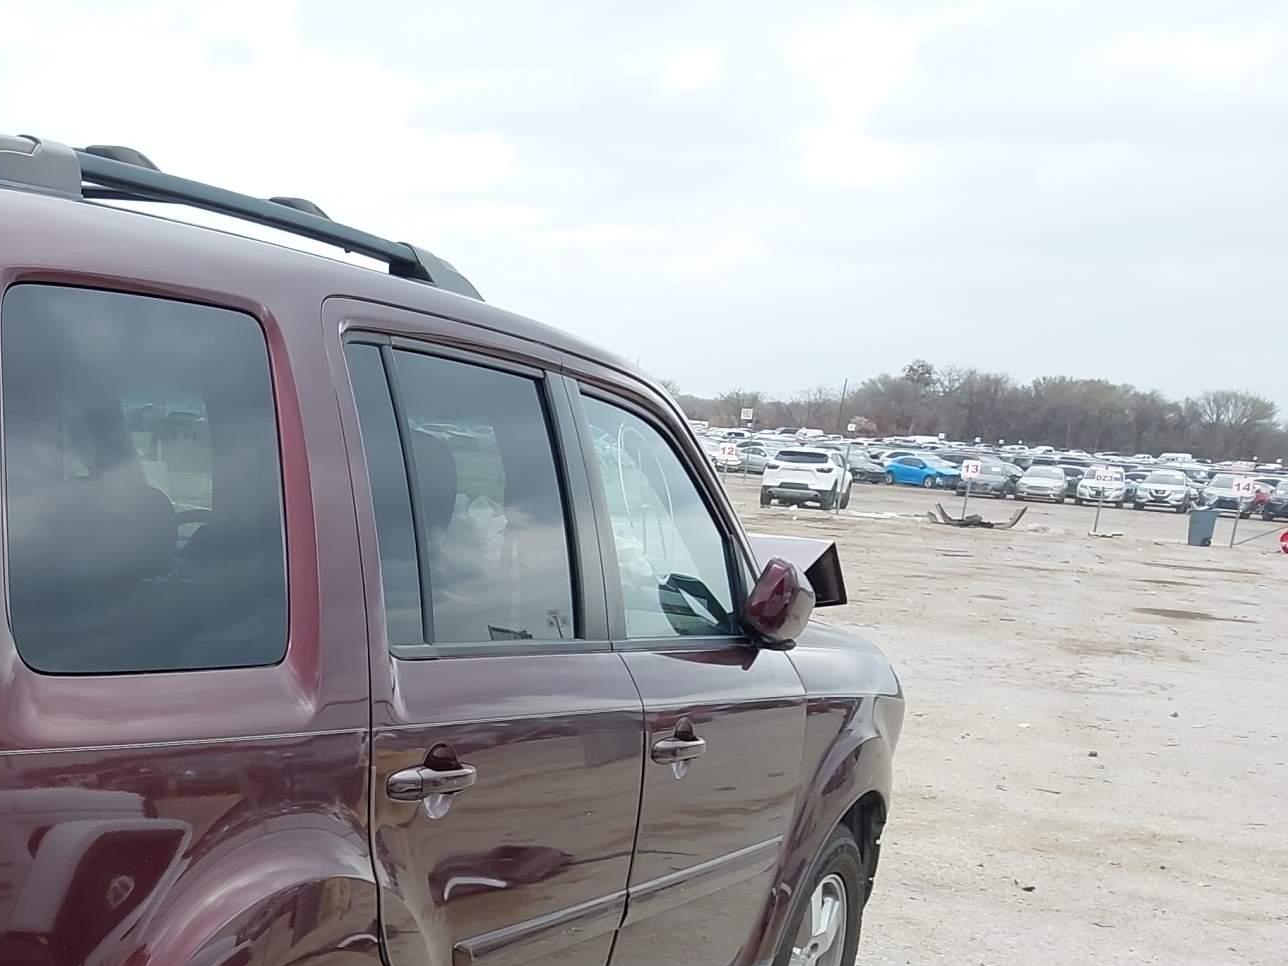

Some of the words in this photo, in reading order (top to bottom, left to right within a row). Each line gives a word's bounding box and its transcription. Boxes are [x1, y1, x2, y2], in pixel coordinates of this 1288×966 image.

[721, 446, 735, 456] 12
[963, 464, 979, 474] 13
[1234, 482, 1251, 492] 14
